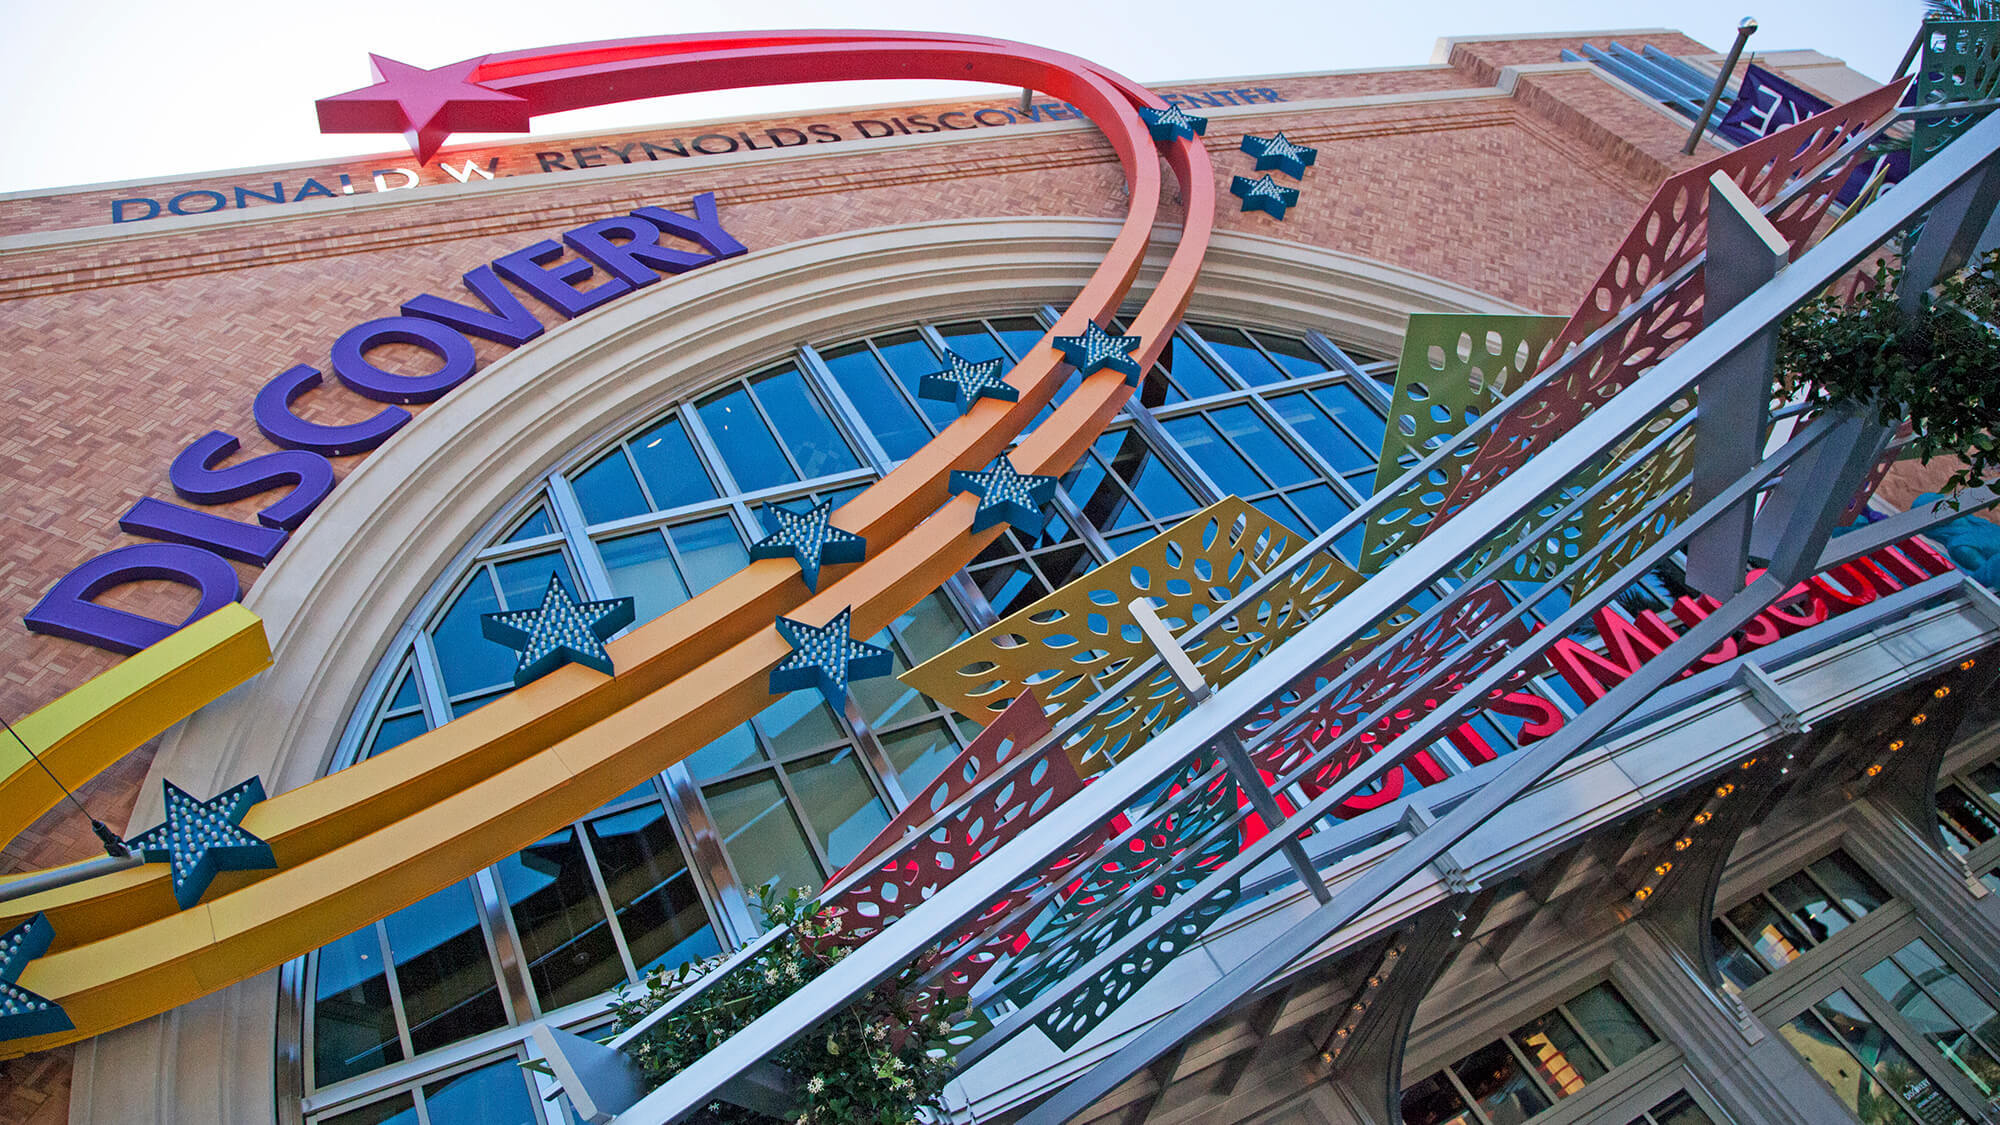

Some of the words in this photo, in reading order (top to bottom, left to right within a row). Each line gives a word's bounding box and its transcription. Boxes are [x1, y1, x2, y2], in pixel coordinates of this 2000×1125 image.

[111, 168, 420, 224] DONALD
[535, 123, 842, 173] REYNOLDS
[851, 102, 1084, 138] DISCOVE
[1158, 87, 1287, 109] ENTER
[23, 191, 748, 656] DISCOVERY
